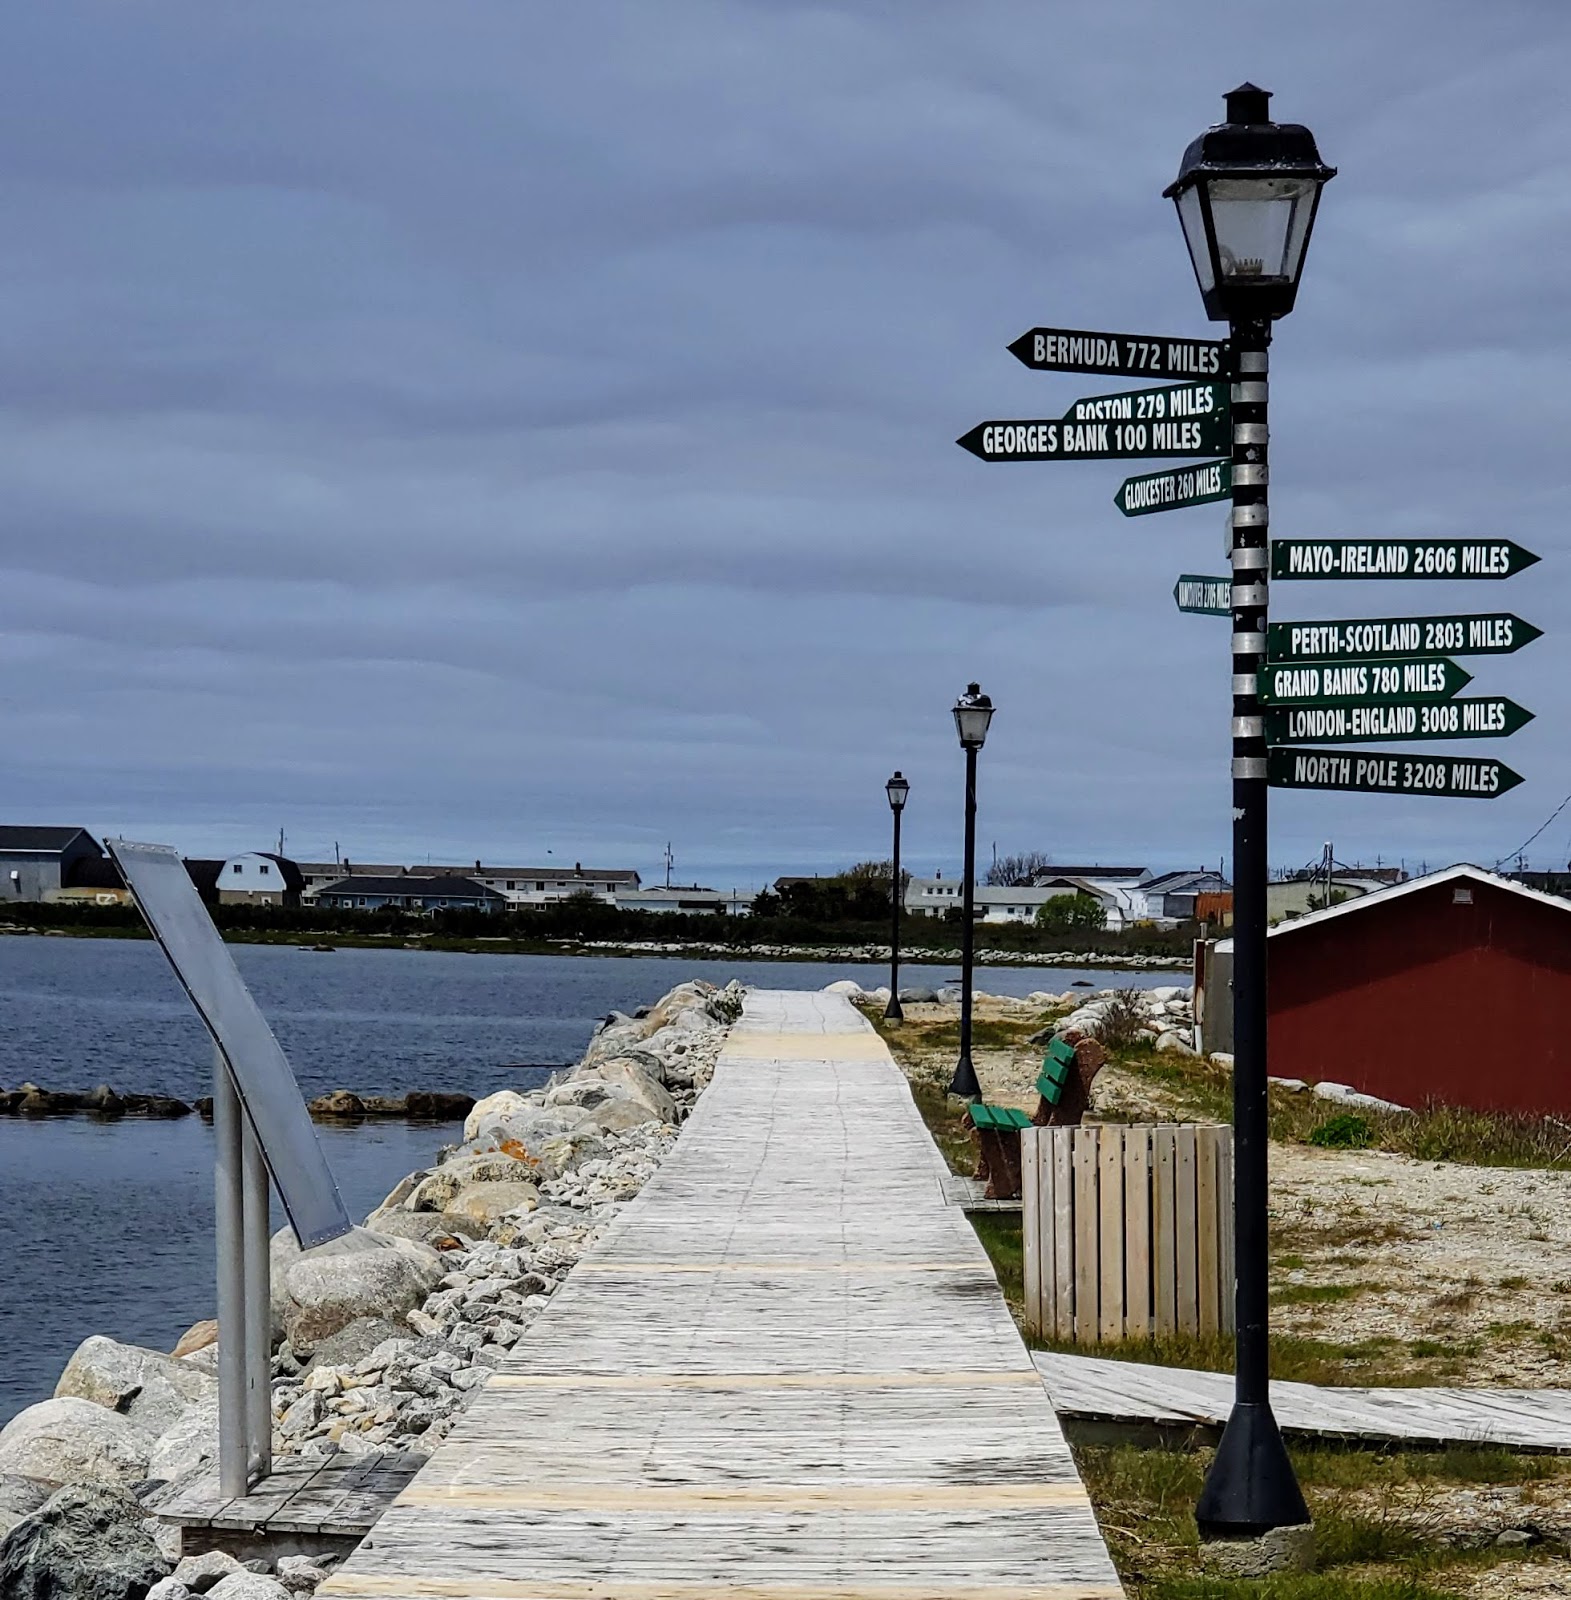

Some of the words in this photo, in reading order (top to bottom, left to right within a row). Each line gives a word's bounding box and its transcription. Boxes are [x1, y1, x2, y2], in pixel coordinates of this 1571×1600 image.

[1033, 334, 1120, 368] BERMUDA
[1126, 342, 1161, 370] 772
[1168, 344, 1220, 374] MILES
[1076, 398, 1132, 420] BOSTON
[1137, 391, 1165, 419] 279
[1170, 385, 1213, 417] MILES
[982, 425, 1058, 454] GEORGES
[1063, 424, 1109, 452] BANK
[1115, 424, 1147, 451] 100
[1152, 422, 1201, 450] MILES
[1125, 476, 1175, 510] GLOUCESTER
[1177, 472, 1194, 499] 260
[1196, 466, 1221, 497] MILES
[1289, 545, 1409, 573] MAYO-IRELAND
[1413, 546, 1456, 573] 2606
[1461, 546, 1510, 574] MILES
[1291, 623, 1420, 655] PERTH-SCOTLAND
[1425, 622, 1464, 649] 2803
[1469, 619, 1513, 647] MILES
[1274, 668, 1319, 697] GRAND
[1323, 666, 1367, 696] BANKS
[1372, 666, 1400, 694] 780
[1404, 663, 1446, 692] MILES
[1288, 706, 1416, 737] LONDON-ENGLAND
[1421, 705, 1459, 732] 3008
[1463, 703, 1505, 731] MILES
[1294, 756, 1350, 784] NORTH
[1356, 759, 1398, 787] POLE
[1403, 762, 1446, 789] 3208
[1451, 764, 1499, 792] MILES
